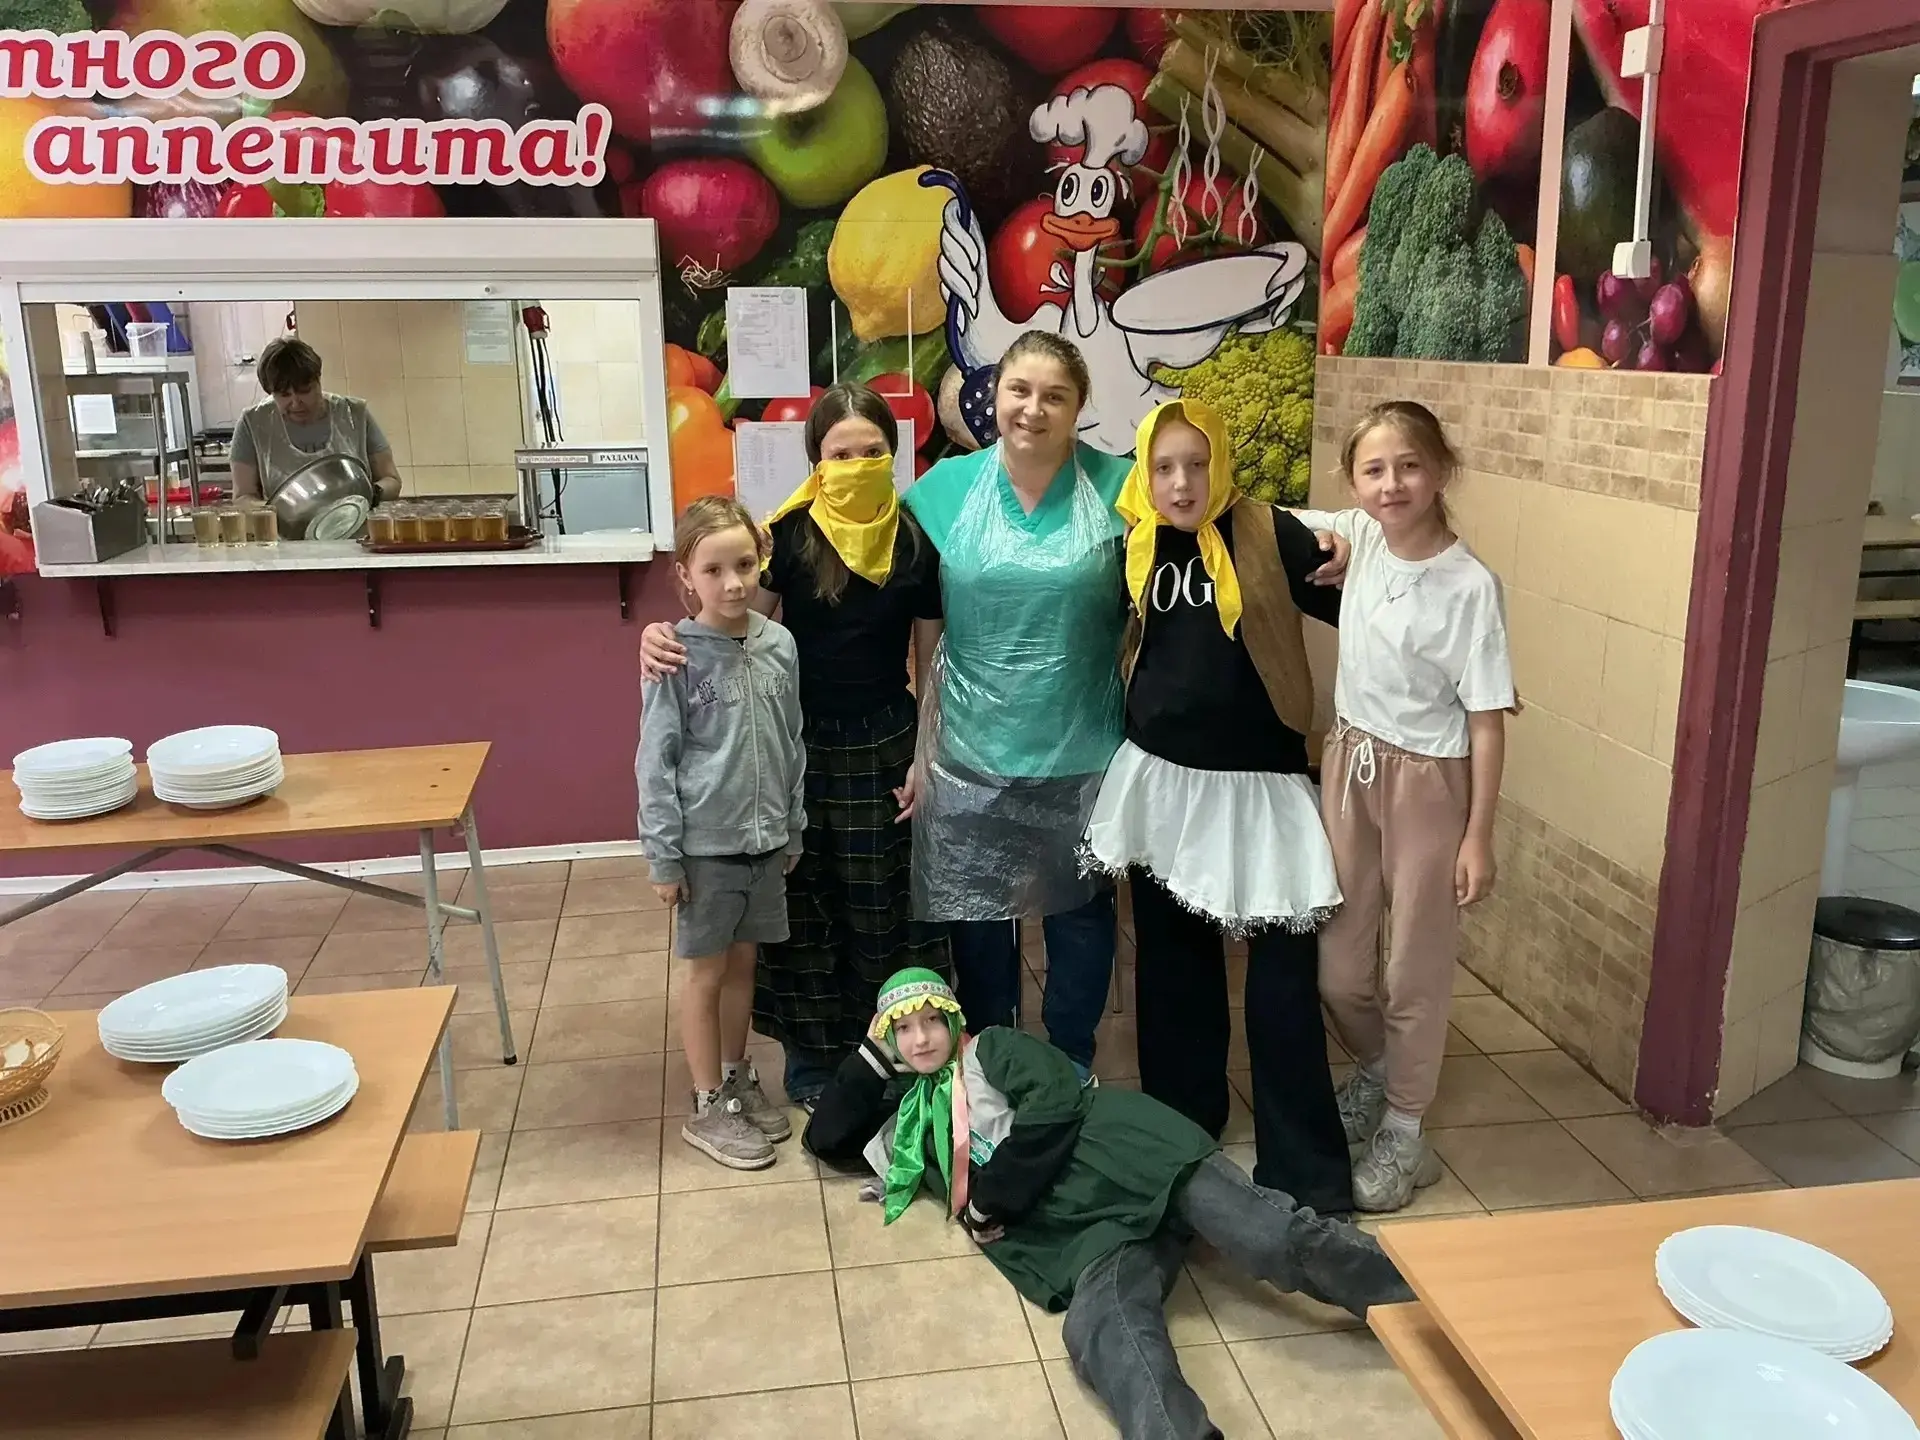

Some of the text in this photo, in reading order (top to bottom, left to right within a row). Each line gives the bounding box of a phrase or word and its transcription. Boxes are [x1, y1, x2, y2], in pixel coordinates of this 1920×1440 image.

[33, 112, 603, 178] аппетита!
[599, 454, 640, 462] РАЗДАЧА
[1152, 555, 1215, 612] OG
